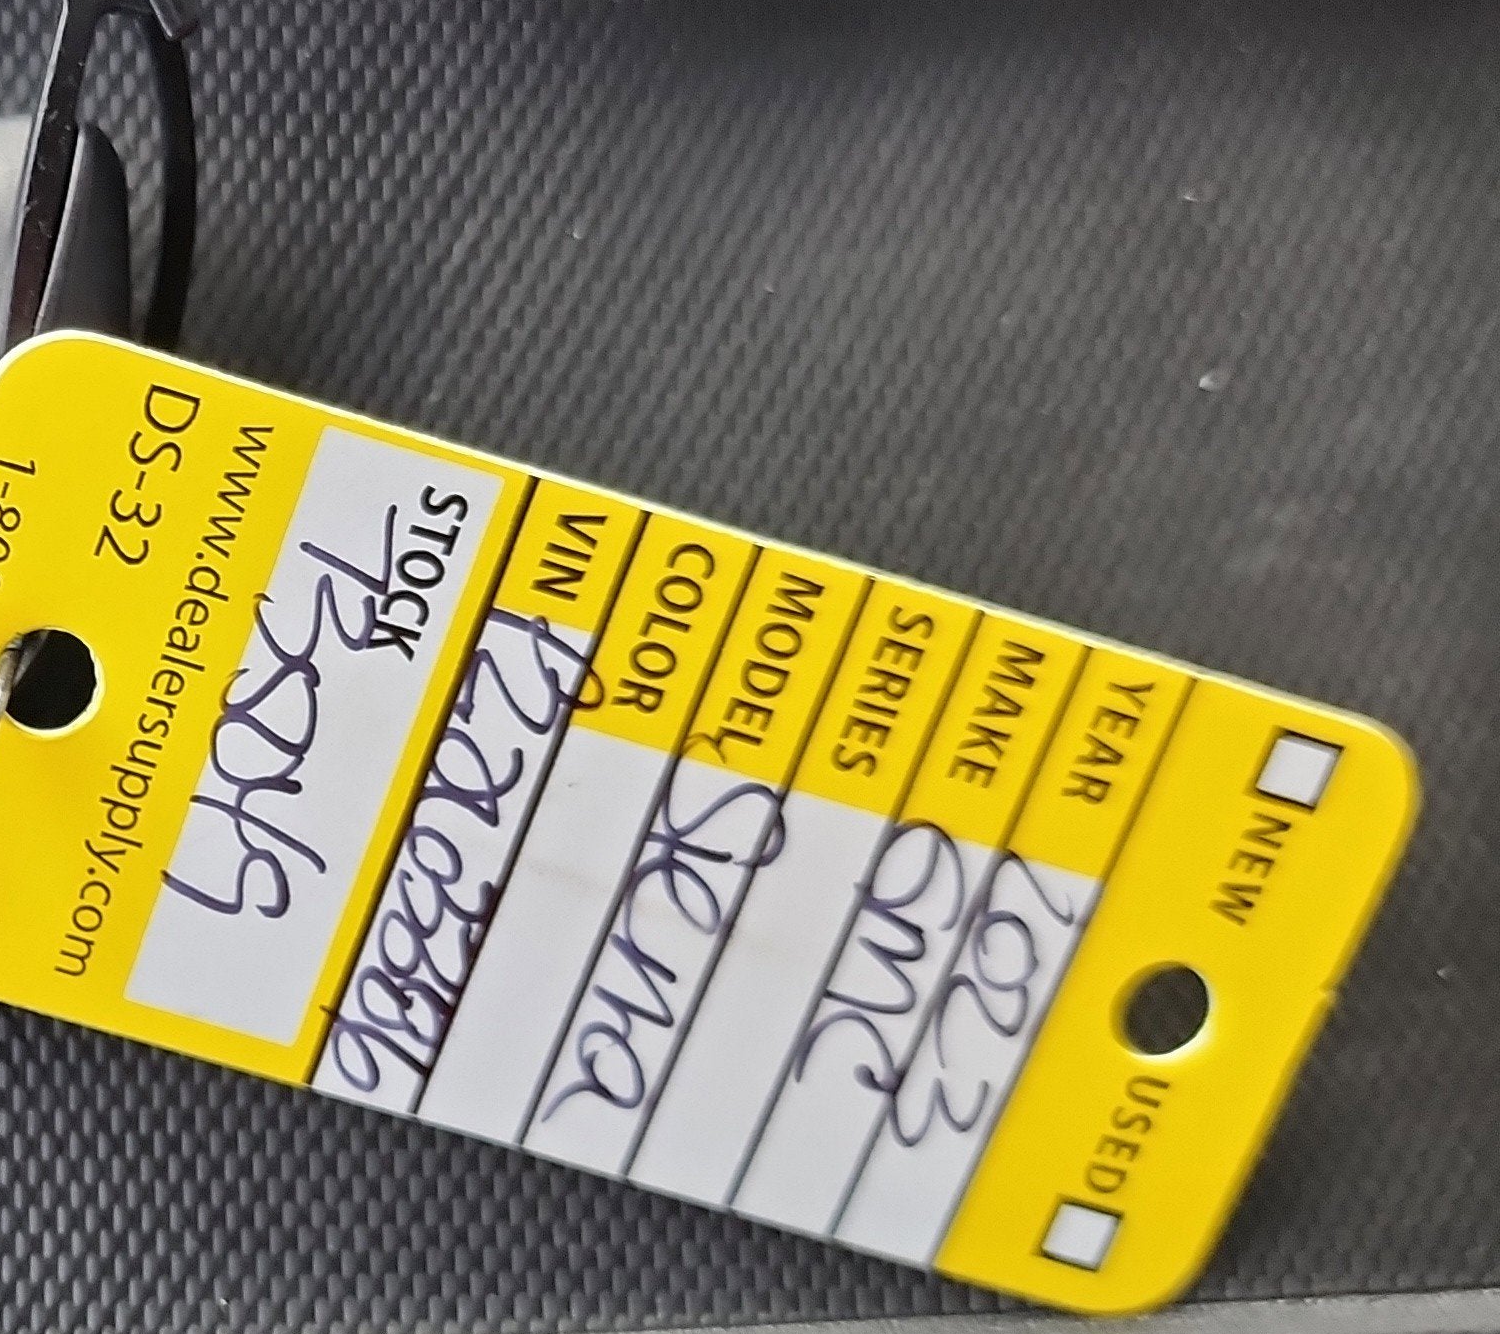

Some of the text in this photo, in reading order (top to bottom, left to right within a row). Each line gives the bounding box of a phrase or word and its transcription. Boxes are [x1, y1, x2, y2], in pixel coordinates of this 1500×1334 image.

[95, 383, 200, 566] DS-32
[530, 514, 607, 602] VIN
[370, 485, 469, 662] STOCK
[611, 544, 716, 715] COLOR
[721, 572, 824, 748] MODEL
[55, 425, 274, 978] www.dealersupply.com
[831, 604, 935, 778] SERIES
[948, 639, 1045, 790] MAKE
[1060, 679, 1157, 806] YEAR
[796, 818, 964, 1092] GMC
[1209, 809, 1291, 928] NEW
[891, 848, 1076, 1147] 2023
[1083, 1074, 1171, 1194] USED
